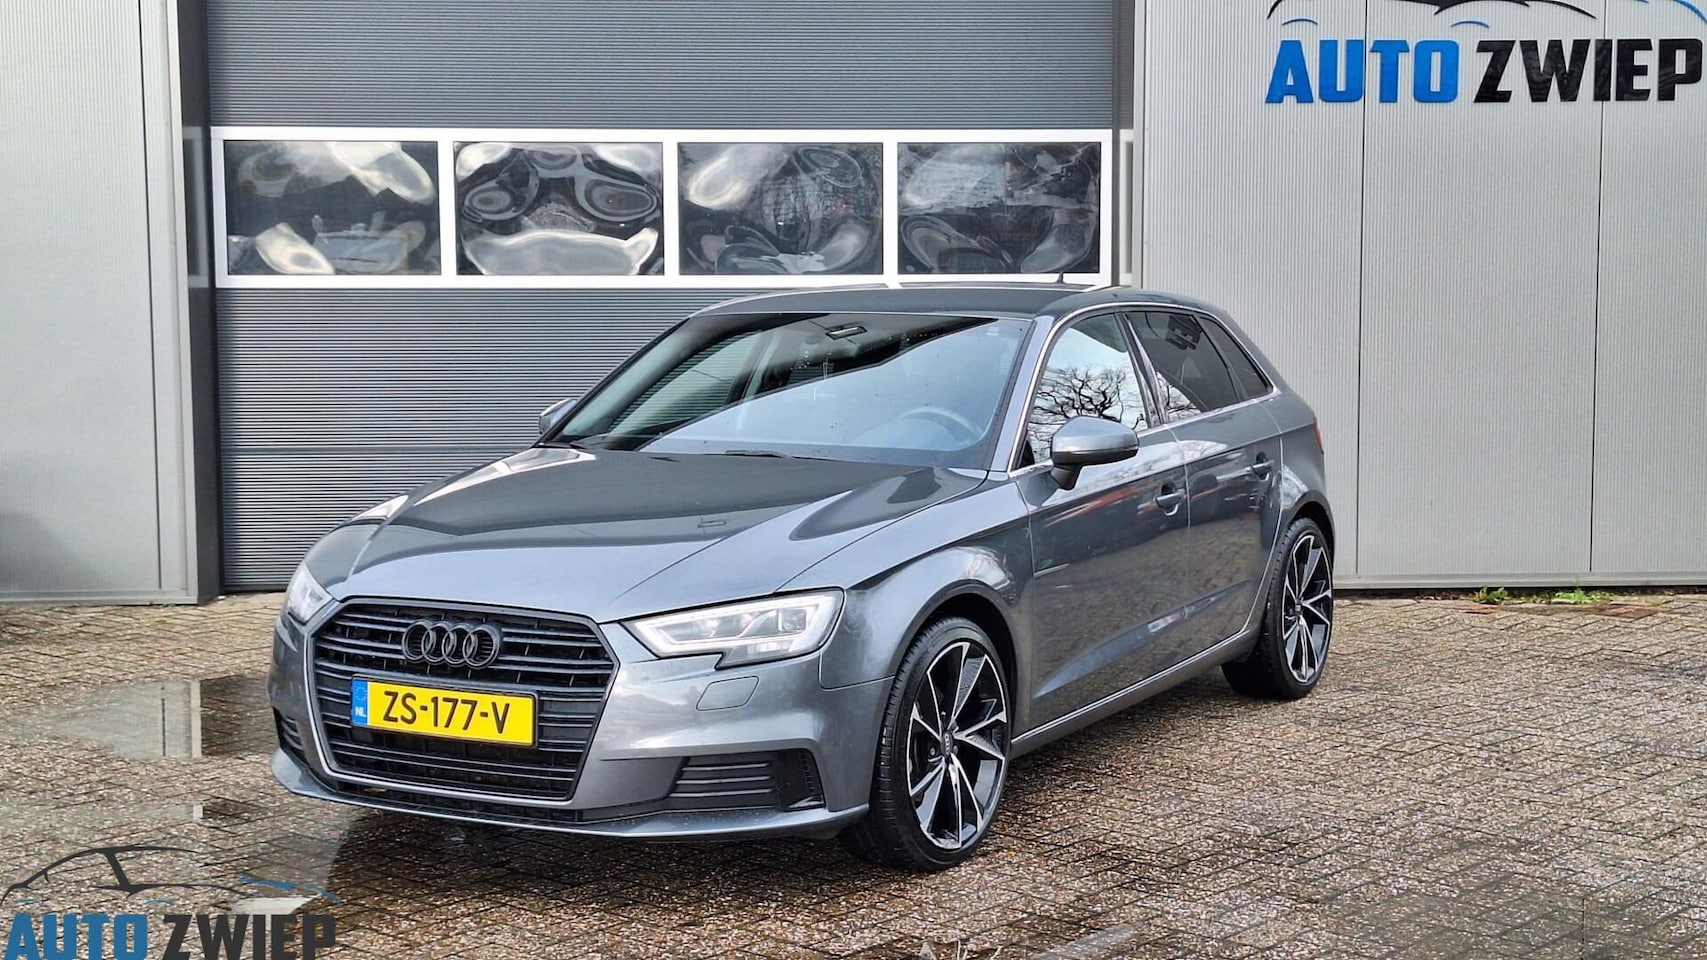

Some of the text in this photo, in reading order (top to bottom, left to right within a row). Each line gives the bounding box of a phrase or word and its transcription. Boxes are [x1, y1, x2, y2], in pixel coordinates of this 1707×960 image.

[1265, 38, 1703, 103] AUTO ZWIEP
[355, 690, 510, 735] NL ZS-177-V
